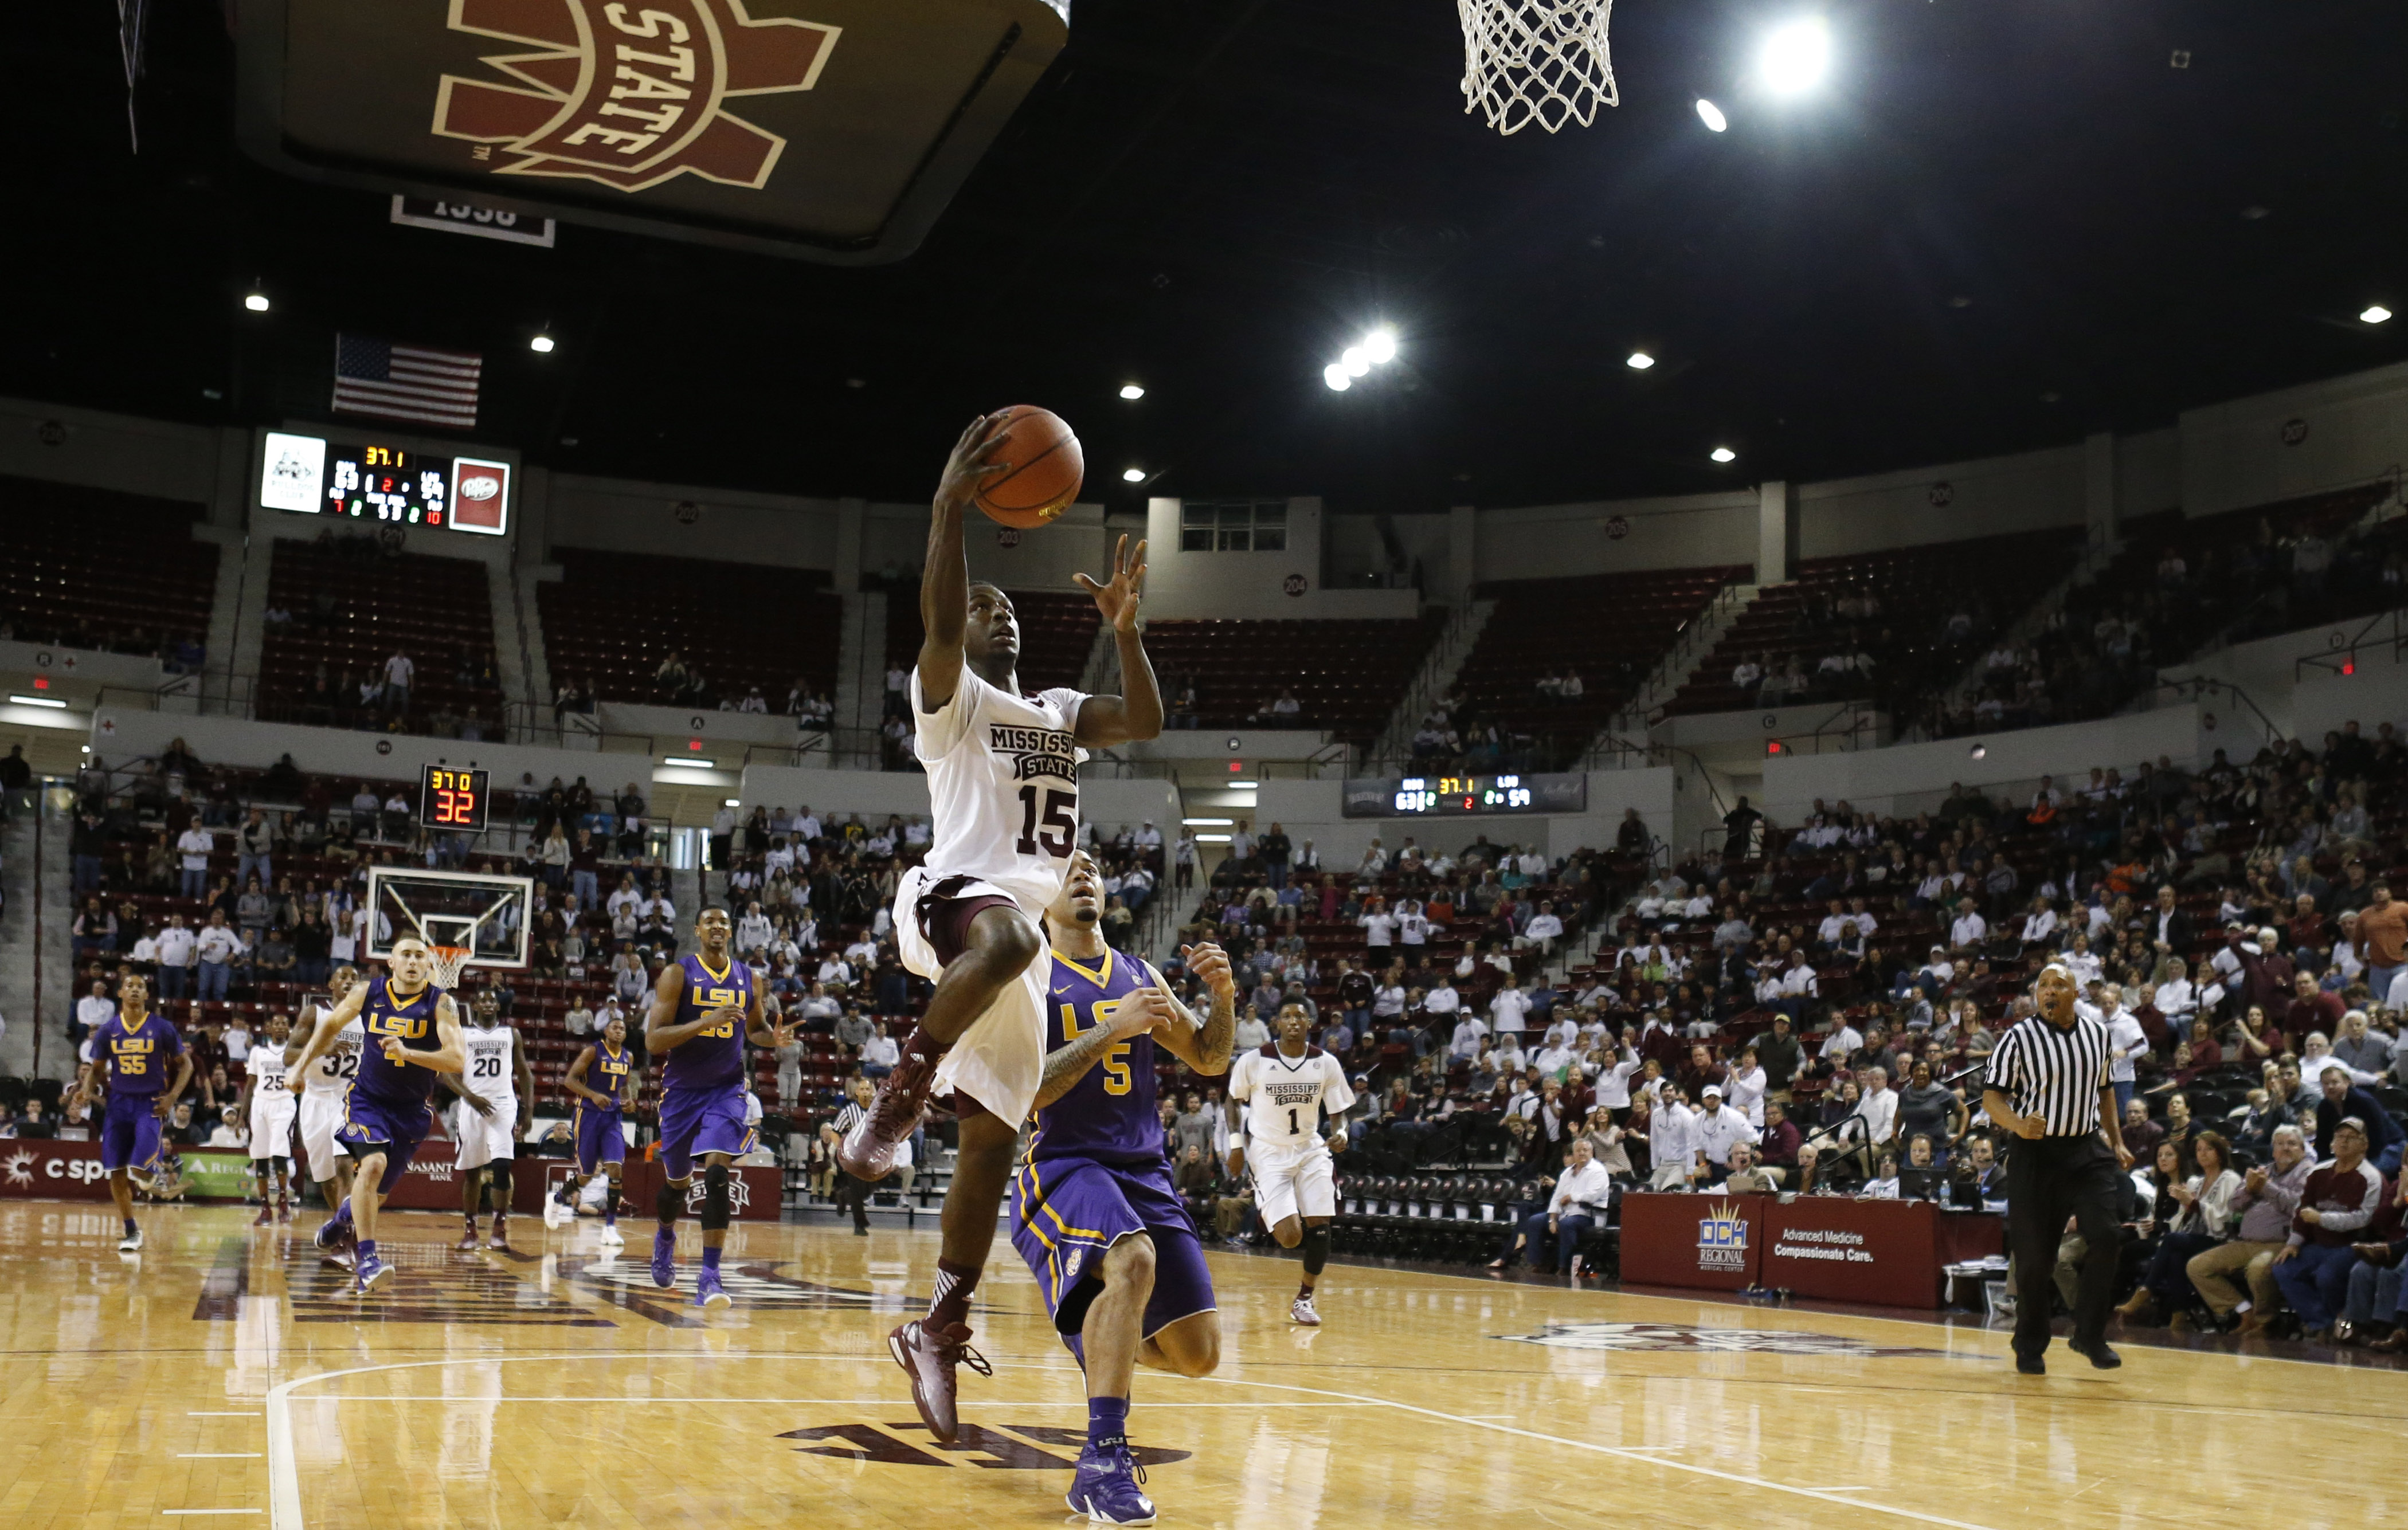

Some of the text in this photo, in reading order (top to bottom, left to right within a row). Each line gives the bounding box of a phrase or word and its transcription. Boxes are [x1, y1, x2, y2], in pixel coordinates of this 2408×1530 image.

[562, 2, 696, 155] STATE
[472, 146, 491, 161] TM
[366, 446, 404, 468] 37.1
[382, 477, 393, 492] 2
[426, 511, 441, 525] 10
[1607, 521, 1627, 536] 205
[1285, 578, 1306, 593] 204
[1027, 758, 1075, 782] STATE
[1440, 778, 1473, 795] 37.1
[436, 790, 474, 823] 32
[1463, 797, 1473, 809] 2
[1017, 785, 1077, 858] 15
[692, 986, 746, 1009] LSU
[367, 1013, 428, 1038] LSU
[111, 1038, 154, 1054] LSU
[467, 1040, 508, 1050] MISSISSIPPI
[119, 1055, 147, 1075] 55
[323, 1054, 358, 1079] 32
[473, 1058, 501, 1077] 20
[600, 1061, 629, 1076] LSU
[1102, 1043, 1132, 1096] 5
[263, 1075, 286, 1091] 25
[610, 1075, 617, 1091] 1
[1280, 1095, 1308, 1105] STATE
[1287, 1108, 1300, 1135] 1
[430, 1174, 453, 1182] BANK
[1700, 1220, 1748, 1247] OCH
[1782, 1227, 1863, 1245] Advanced Medicine
[1700, 1248, 1745, 1264] REGIONAL
[1774, 1243, 1874, 1263] Compassionate Care.
